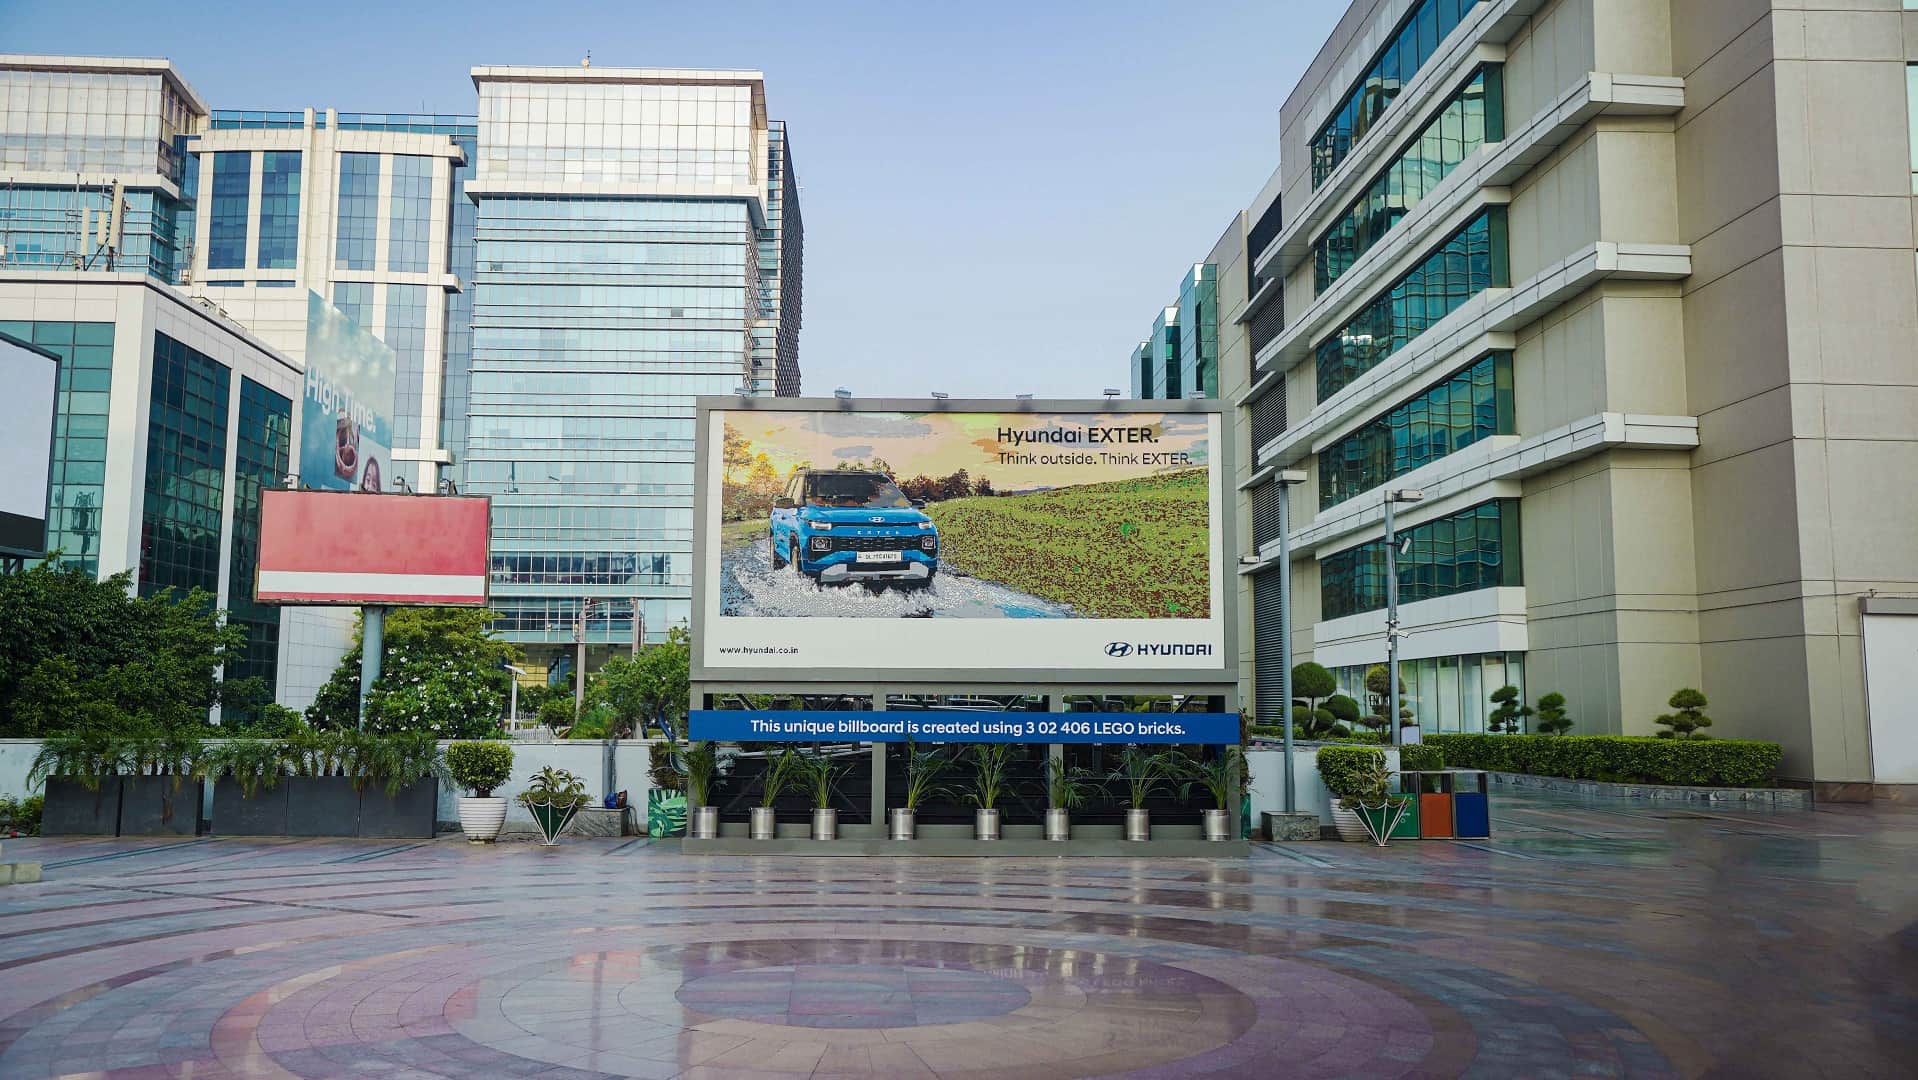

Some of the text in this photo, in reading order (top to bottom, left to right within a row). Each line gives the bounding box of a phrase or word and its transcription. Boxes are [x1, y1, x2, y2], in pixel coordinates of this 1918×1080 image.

[306, 365, 377, 433] High Time.
[997, 427, 1159, 446] Hyundai EXTER.
[1000, 452, 1193, 465] Think outside. Think EXTER.
[719, 646, 799, 655] www.hyundai.co.in
[1137, 644, 1212, 656] HYUNDAI
[750, 719, 1186, 736] This unique billboard is created using 3 02 406 LEGO bricks.
